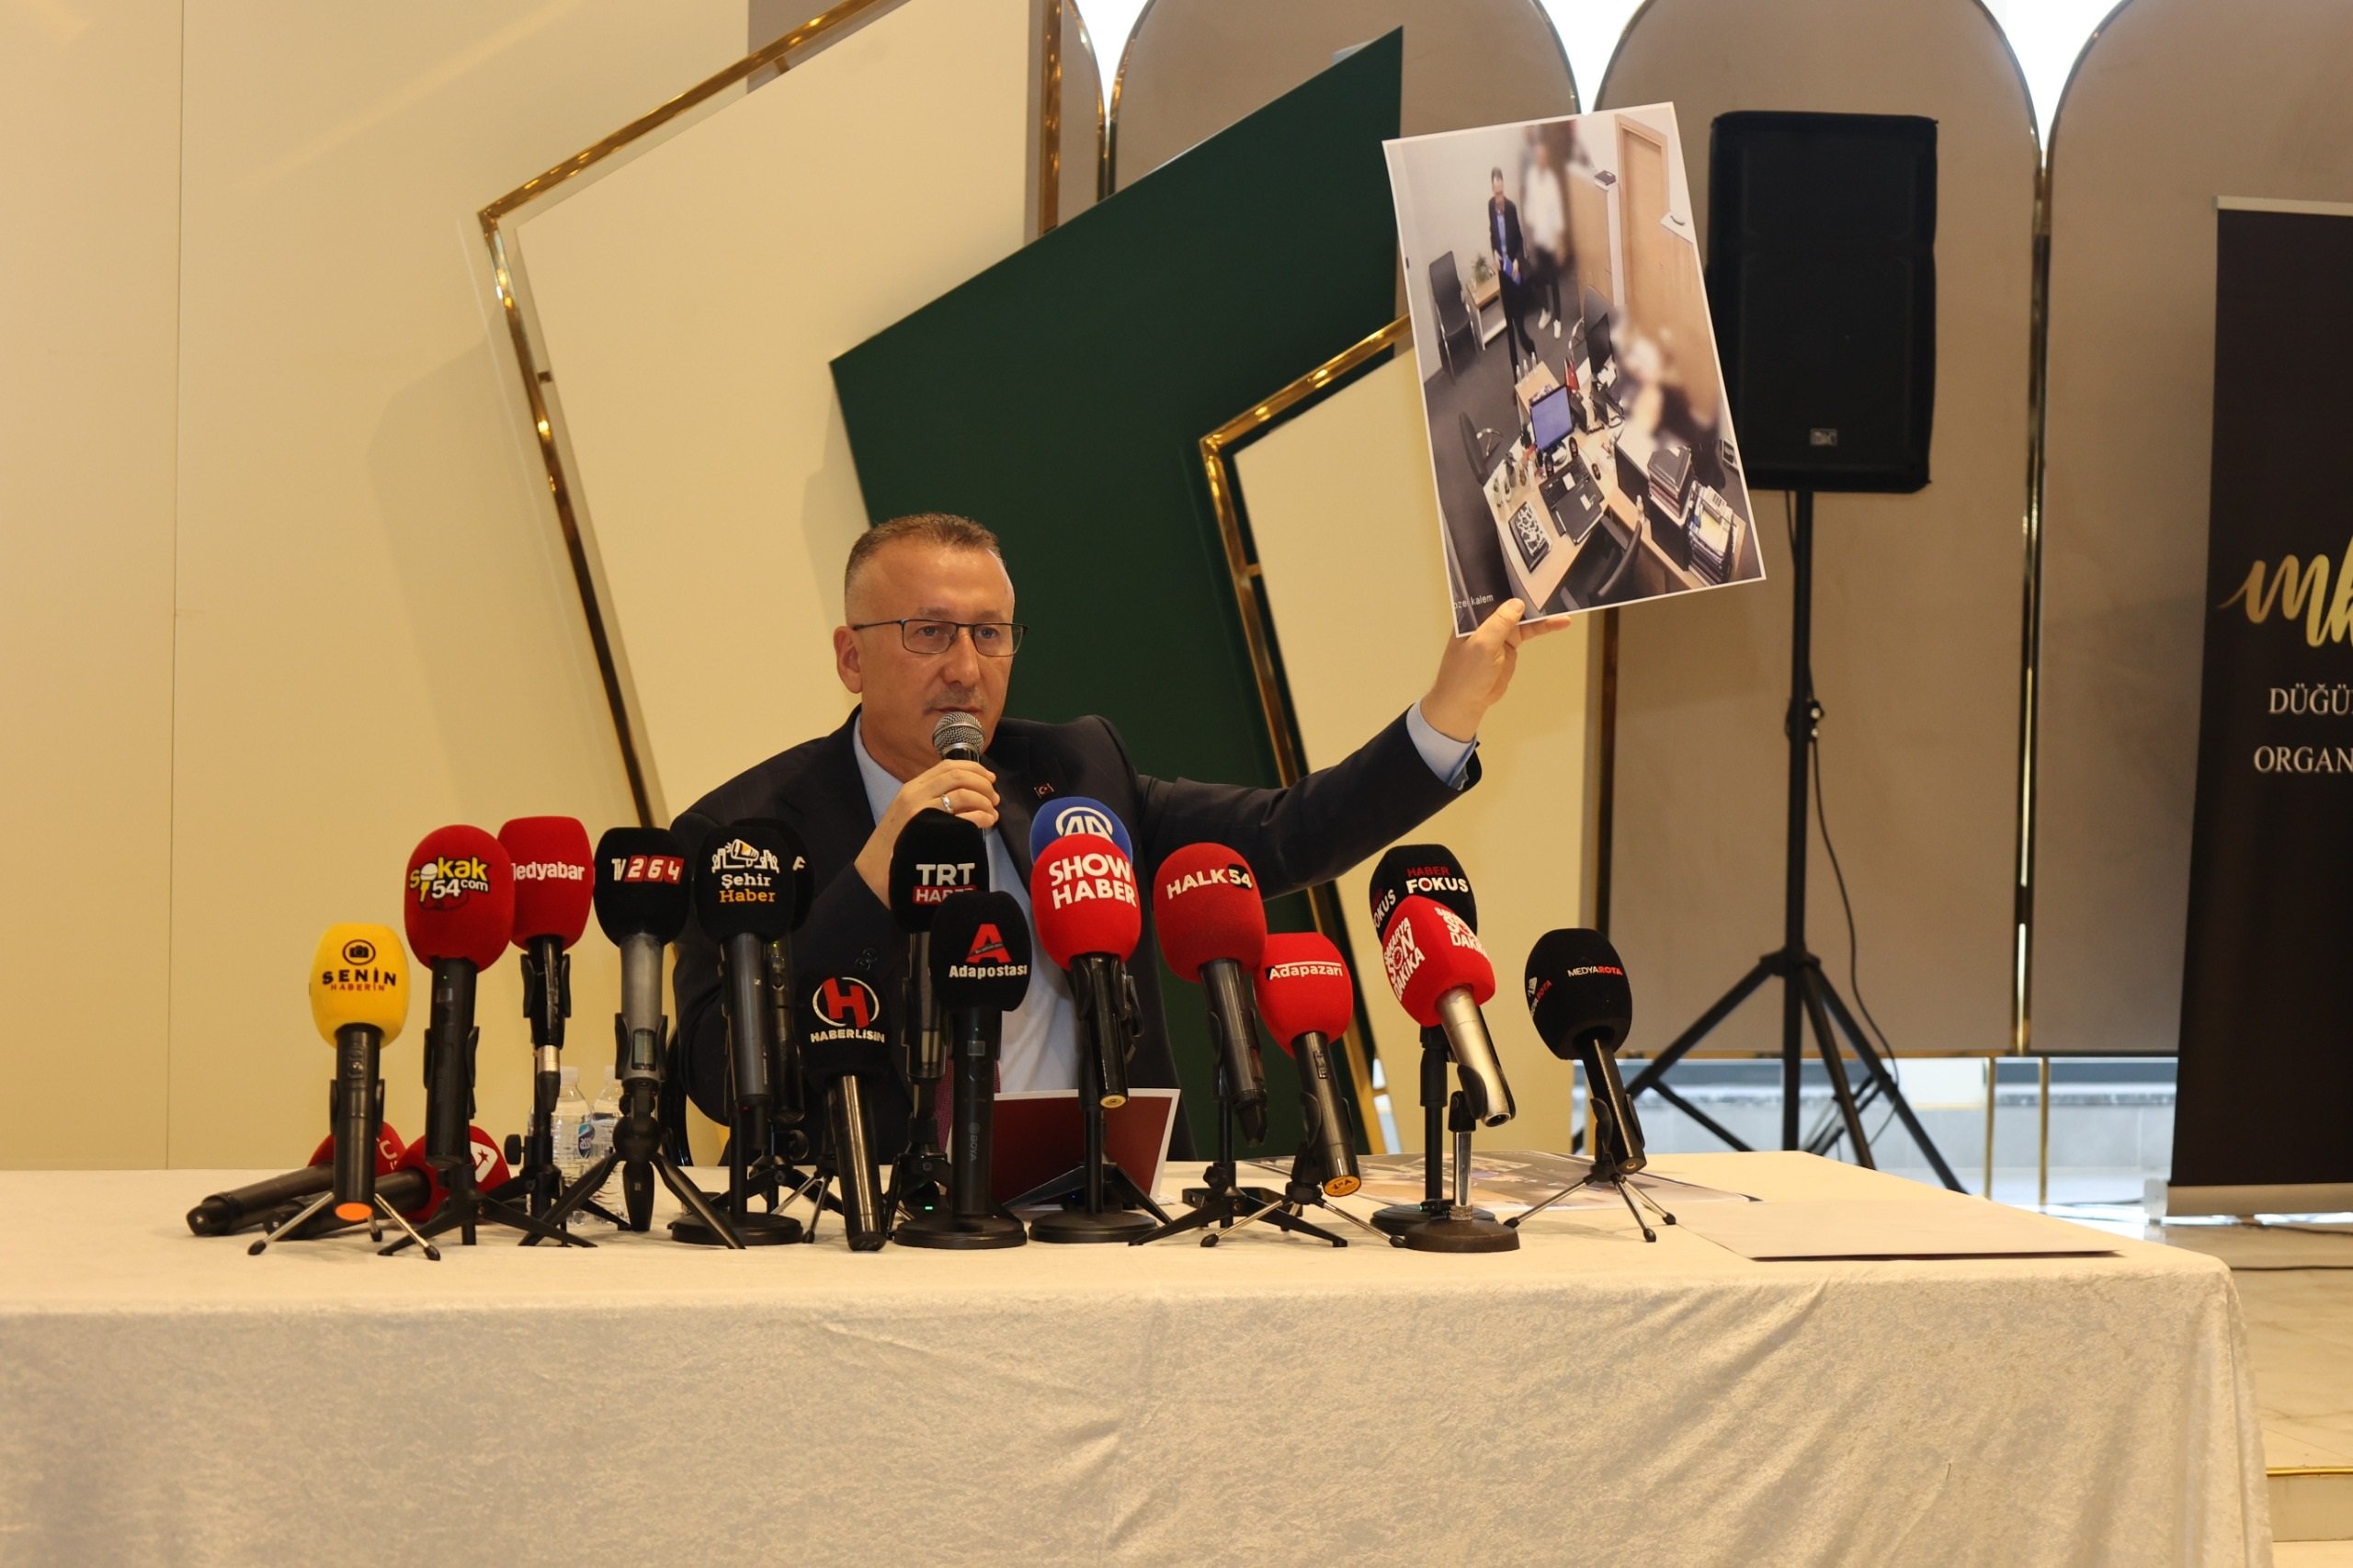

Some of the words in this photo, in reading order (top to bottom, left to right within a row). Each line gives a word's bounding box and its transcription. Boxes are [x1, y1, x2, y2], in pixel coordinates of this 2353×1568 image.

[2268, 682, 2353, 716] DÜĞÜ
[915, 862, 976, 886] TRT
[1049, 853, 1131, 887] SHOW
[1406, 866, 1451, 878] HABER
[721, 873, 772, 889] Şehir
[1405, 877, 1470, 894] FOKUS
[719, 888, 776, 903] Haber
[1051, 879, 1137, 910] HABER
[1373, 889, 1397, 928] OKUS
[949, 964, 1029, 980] Adapostası
[1268, 964, 1344, 981] Adapazarı
